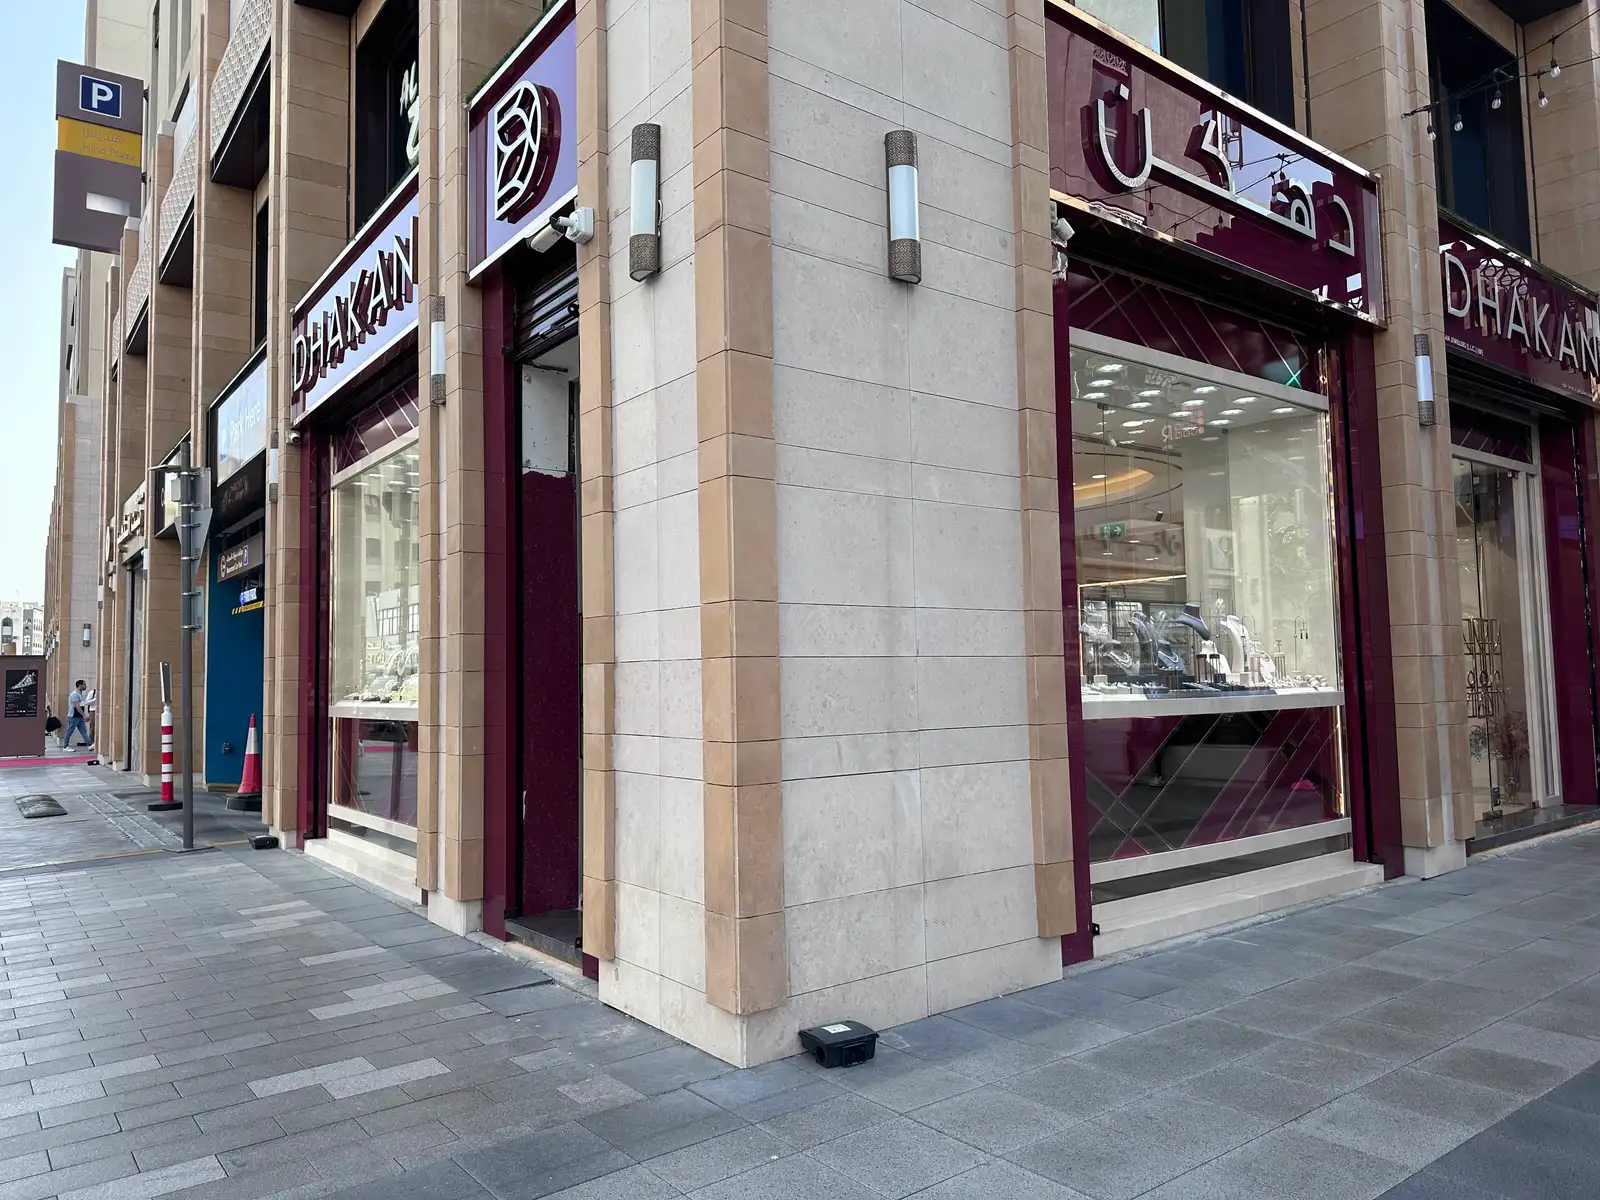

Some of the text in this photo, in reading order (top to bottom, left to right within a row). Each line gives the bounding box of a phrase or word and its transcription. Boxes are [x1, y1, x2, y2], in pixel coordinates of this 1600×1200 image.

[91, 82, 114, 109] P
[82, 141, 106, 155] Hind
[293, 216, 418, 393] DHAKAN
[1444, 252, 1600, 378] DHAKAN
[230, 411, 244, 446] Park
[245, 401, 261, 433] Here
